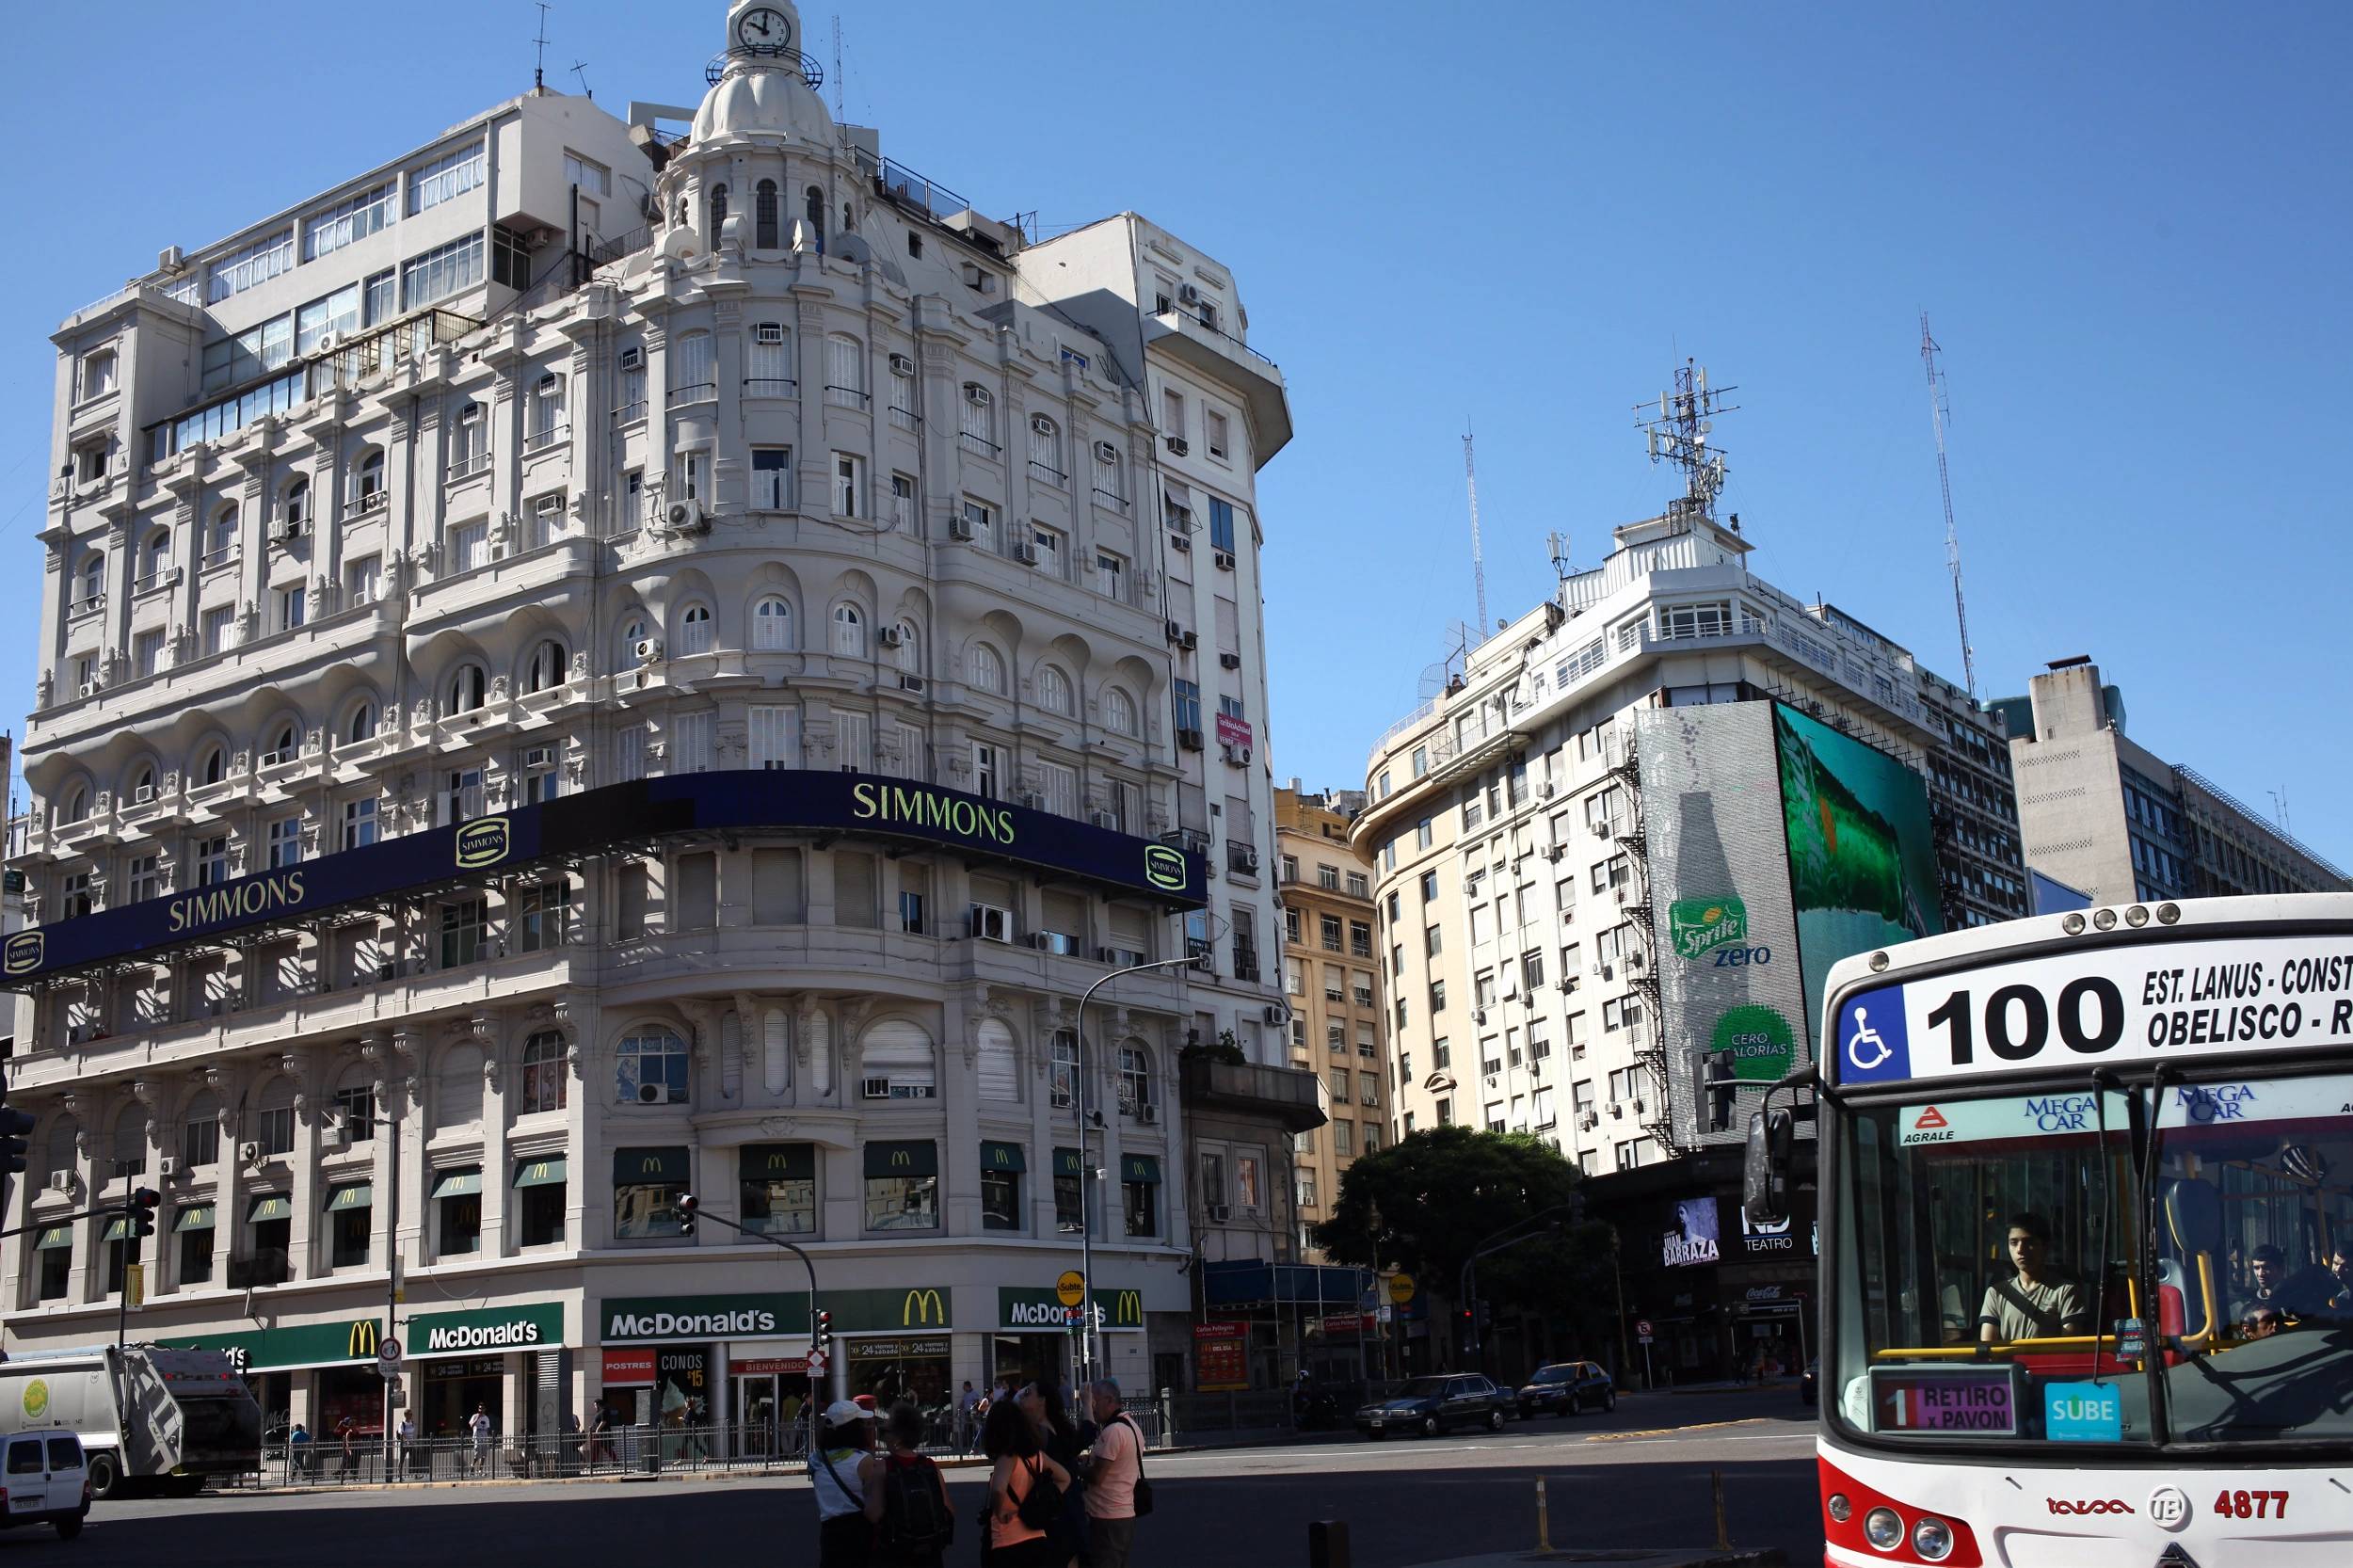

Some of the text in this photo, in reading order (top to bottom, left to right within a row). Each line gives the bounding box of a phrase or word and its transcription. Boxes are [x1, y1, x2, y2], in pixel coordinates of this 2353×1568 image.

[853, 782, 1016, 845] SIMMONS
[462, 835, 504, 851] SIMMONS
[1149, 858, 1182, 876] SIMMONS
[169, 871, 305, 933] SIMMONS
[1682, 918, 1738, 954] Sprite
[8, 945, 40, 960] SIMMONS
[1714, 946, 1771, 968] zero
[2142, 968, 2184, 1006] EST.
[2189, 962, 2262, 1001] LANUS
[2281, 955, 2353, 996] CONST
[1927, 975, 2125, 1065] 100
[2147, 1000, 2302, 1048] OBELISCO
[1731, 1032, 1769, 1045] CERO
[2175, 1084, 2258, 1107] MEGA
[2024, 1096, 2098, 1117] MEGA
[2189, 1102, 2245, 1121] CAR
[2037, 1113, 2089, 1131] CAR
[1903, 1130, 1955, 1144] AGRALE
[1664, 1234, 1681, 1251] JUAN
[1745, 1237, 1793, 1252] TEATRO
[1663, 1240, 1720, 1267] BARRAZA
[1060, 1282, 1082, 1292] Subte
[610, 1309, 776, 1336] McDonald's
[1011, 1302, 1107, 1324] McDons
[428, 1320, 537, 1350] McDonald's
[861, 1345, 874, 1355] 24
[912, 1342, 924, 1353] 24
[605, 1361, 652, 1371] POSTRES
[661, 1353, 704, 1370] CONOS
[745, 1361, 807, 1371] BIENVENIDO
[687, 1369, 704, 1387] $15
[1885, 1388, 1907, 1426] 1
[1924, 1386, 2007, 1408] RETIRO
[1942, 1410, 2007, 1431] PAVON
[2052, 1399, 2114, 1421] SUBE
[2214, 1490, 2289, 1519] 4877
